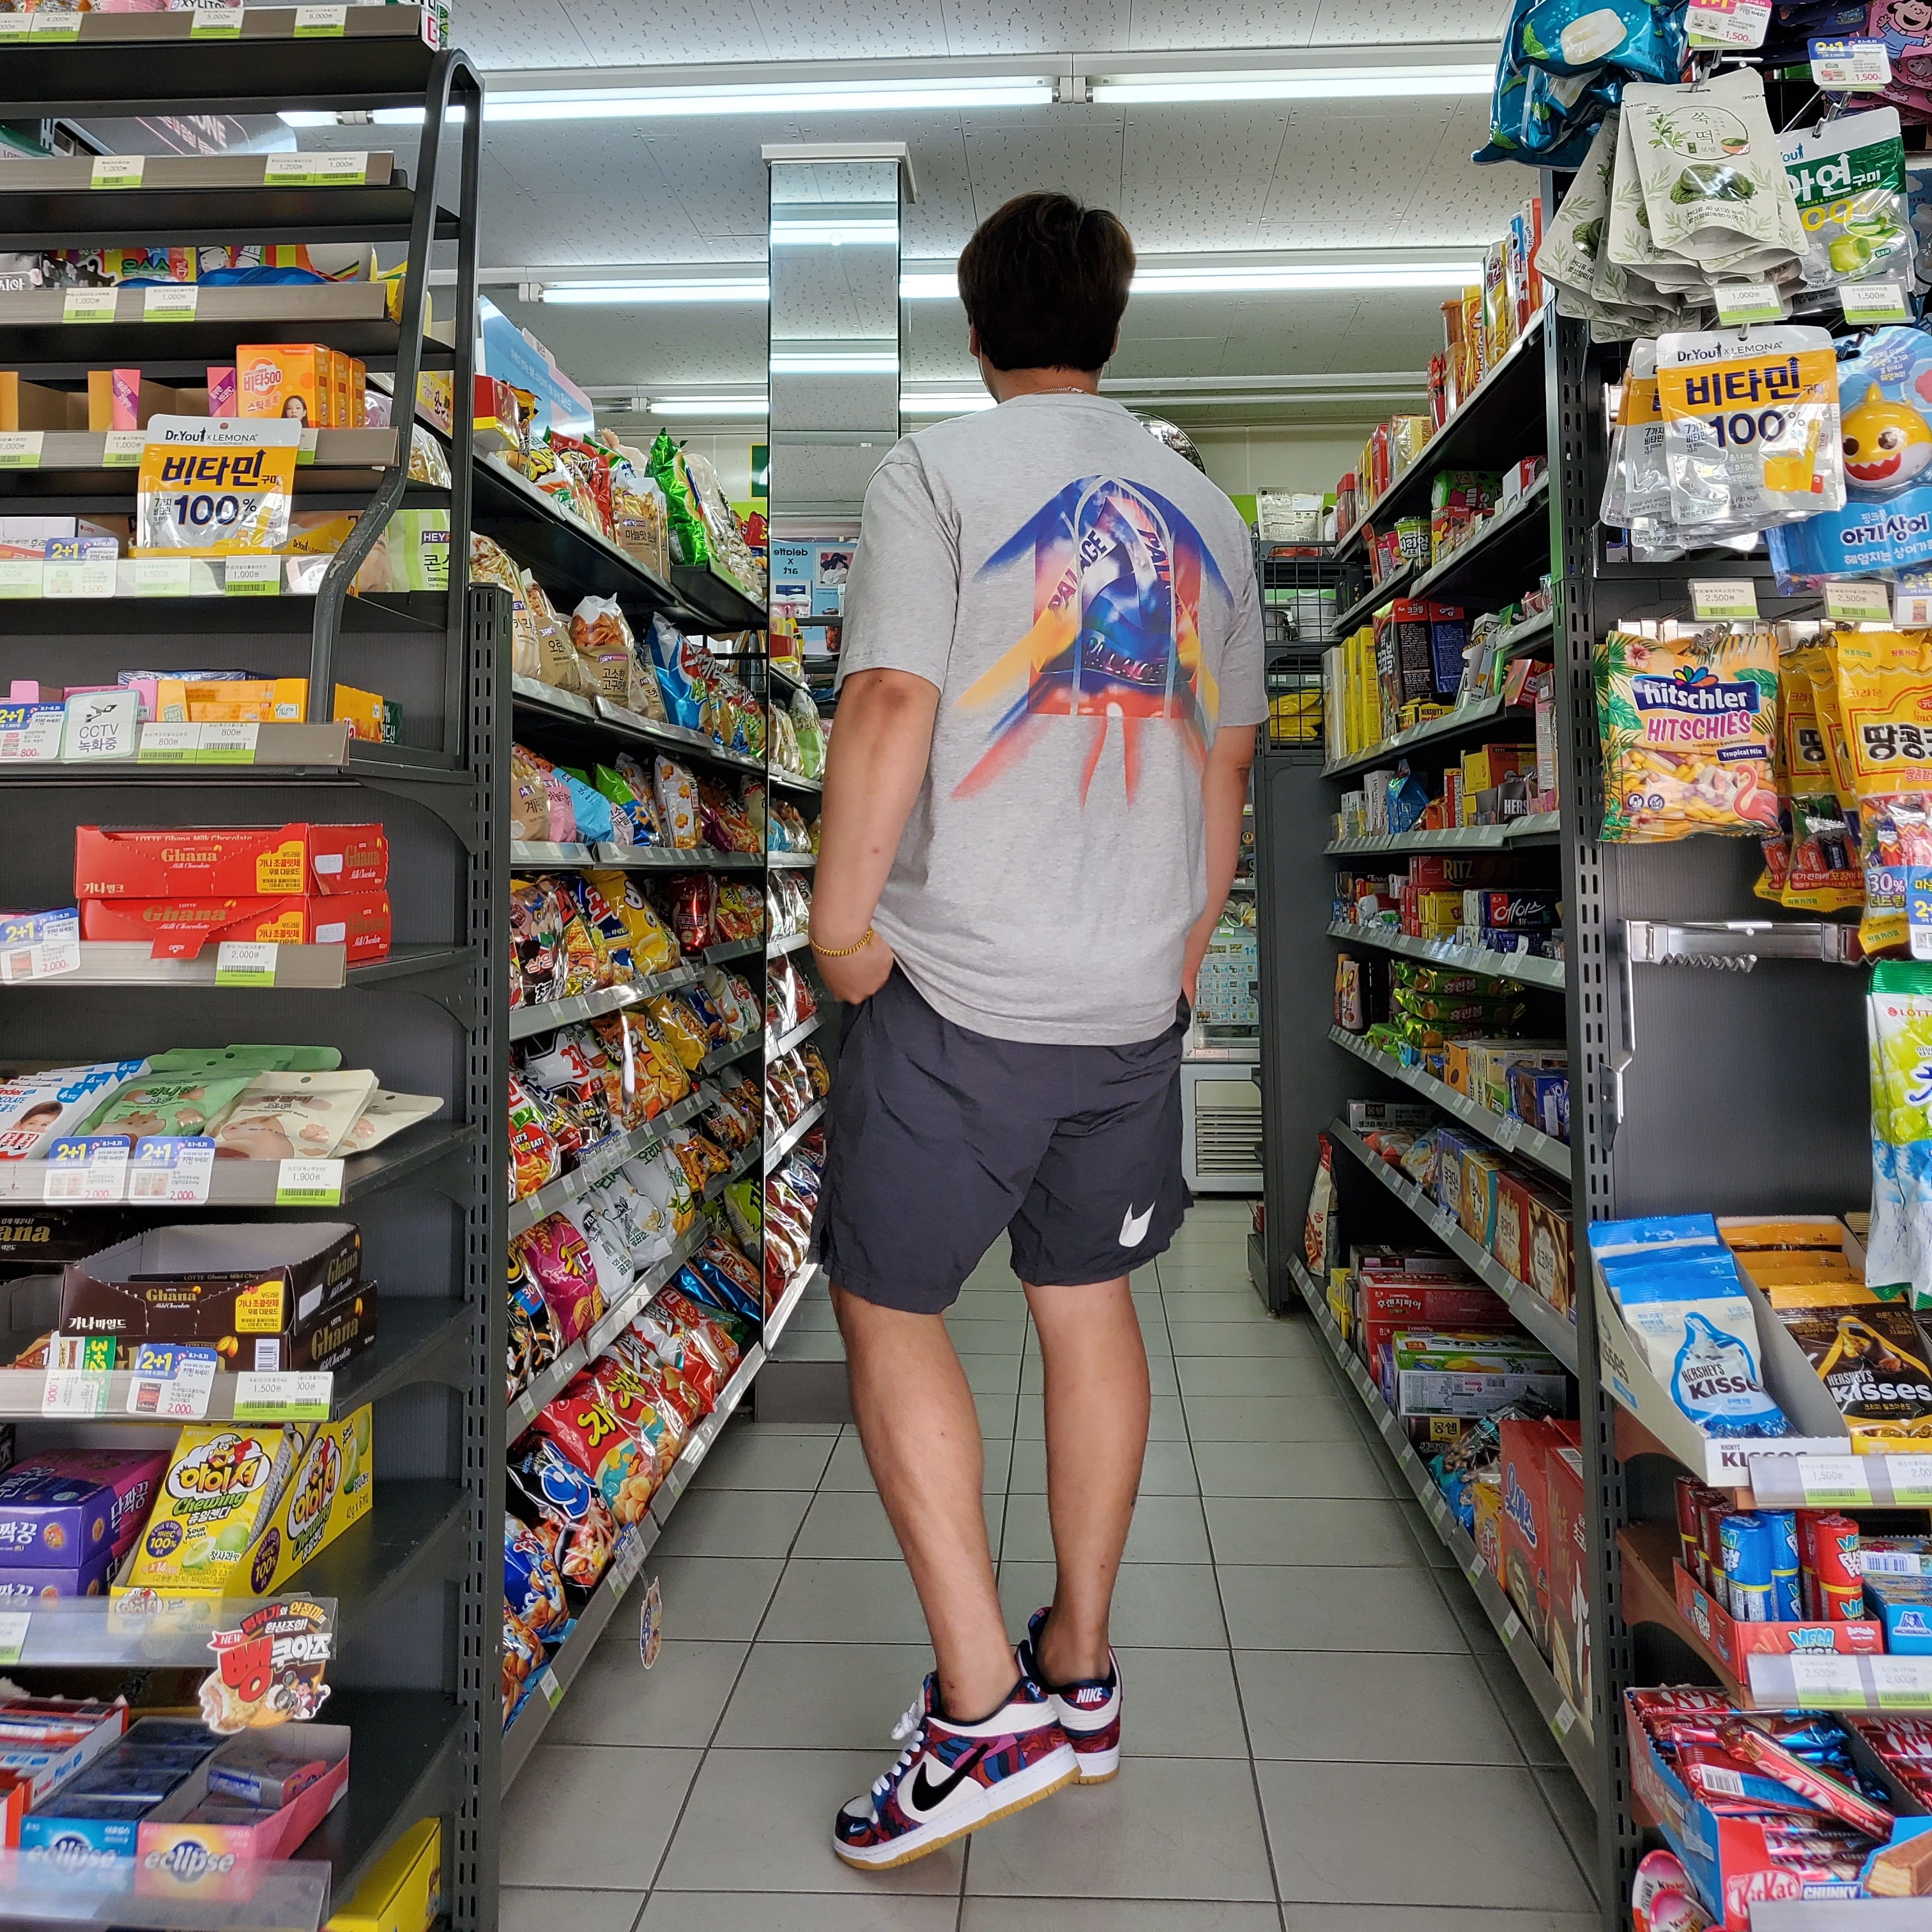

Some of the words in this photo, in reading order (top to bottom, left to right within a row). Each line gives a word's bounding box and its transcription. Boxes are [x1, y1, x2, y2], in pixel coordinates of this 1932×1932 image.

[1725, 30, 1749, 42] 1,500
[1815, 41, 1844, 55] 2+1
[1855, 72, 1879, 81] 1,500
[1852, 170, 1881, 187] 구미
[1731, 291, 1760, 300] 1,000원
[1857, 291, 1885, 300] 1,500원
[1677, 347, 1716, 363] Dr.You
[1731, 341, 1782, 355] LEMONA
[243, 370, 281, 392] 비타500
[1685, 356, 1802, 407] 비타민
[165, 429, 203, 442] Dr.You
[1708, 410, 1805, 448] 100%
[1686, 432, 1708, 444] 비타민
[160, 448, 267, 487] 비타민
[174, 494, 257, 528] 100%
[1842, 514, 1928, 546] 아기상어
[51, 542, 79, 559] 2+1
[1844, 549, 1891, 565] 헤엄치는
[82, 585, 103, 594] 1,500
[1644, 681, 1748, 711] hitschler
[0, 708, 25, 723] 2+1
[79, 723, 119, 739] CCTV
[221, 728, 241, 736] 800원
[1646, 710, 1752, 743] HITSCHIES
[78, 737, 118, 753] 녹화중
[1722, 749, 1749, 759] Tropical
[160, 848, 218, 862] Ghana
[345, 845, 380, 868] Ghana
[259, 859, 272, 868] 가나
[1442, 859, 1473, 880] RITZ
[1868, 873, 1906, 893] 30%
[1870, 894, 1906, 909] 더드림
[142, 900, 227, 922] Ghana
[6, 921, 34, 942] 2+1
[258, 929, 272, 939] 가나
[231, 949, 259, 960] 2,000원
[42, 960, 66, 973] 2,000
[513, 1132, 528, 1144] LET'S
[530, 1137, 545, 1149] EAT!
[57, 1143, 87, 1162] 2+1
[142, 1143, 171, 1162] 2+1
[292, 1172, 320, 1181] 1,900원
[169, 1190, 194, 1200] 2,000
[326, 1254, 358, 1286] Ghana
[146, 1288, 197, 1302] Ghana
[238, 1300, 251, 1308] 가나
[1376, 1298, 1422, 1311] 후렌치파이
[310, 1318, 359, 1361] Ghana
[89, 1340, 109, 1373] 3+2
[142, 1351, 172, 1370] 2+1
[1681, 1363, 1725, 1383] HERSHEY'S
[1827, 1369, 1874, 1386] HERSHEY'S
[254, 1383, 282, 1393] 1,500원
[167, 1403, 192, 1414] 2,000
[180, 1457, 261, 1492] 아이셔
[294, 1454, 340, 1524] 아이셔
[111, 1480, 149, 1529] 단짝꿍
[172, 1491, 250, 1516] Chewing
[187, 1505, 231, 1526] 츄잉캔디
[186, 1526, 206, 1535] SOUR
[150, 1537, 177, 1549] 100%
[210, 1550, 241, 1562] 청사과맛
[264, 1618, 308, 1634] 환상조합!
[220, 1634, 243, 1644] NEW
[1788, 1628, 1835, 1648] MEGA
[1076, 1687, 1103, 1703] NIKE
[27, 1839, 116, 1875] eclipse
[144, 1841, 235, 1882] eclipse
[1802, 1885, 1859, 1900] CHUNKY
